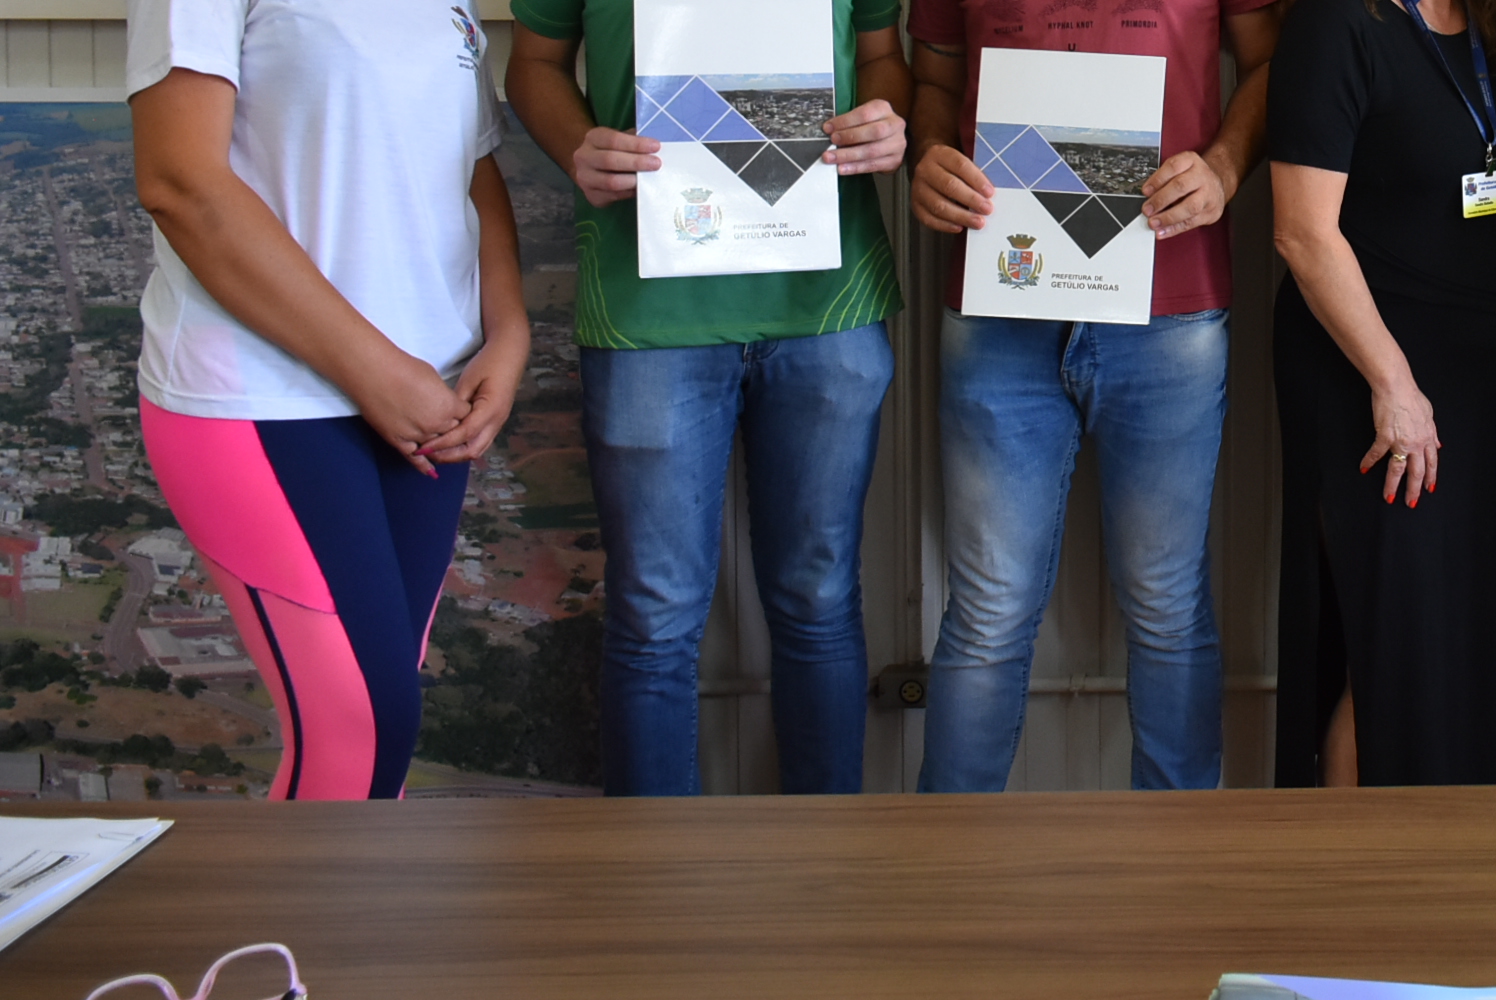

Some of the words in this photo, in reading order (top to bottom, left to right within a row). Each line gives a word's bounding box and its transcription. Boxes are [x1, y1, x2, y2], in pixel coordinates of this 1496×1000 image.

[1121, 20, 1157, 28] PRIMORDIA
[1051, 281, 1085, 289] GETÚLIO
[1087, 283, 1119, 291] VARGAS
